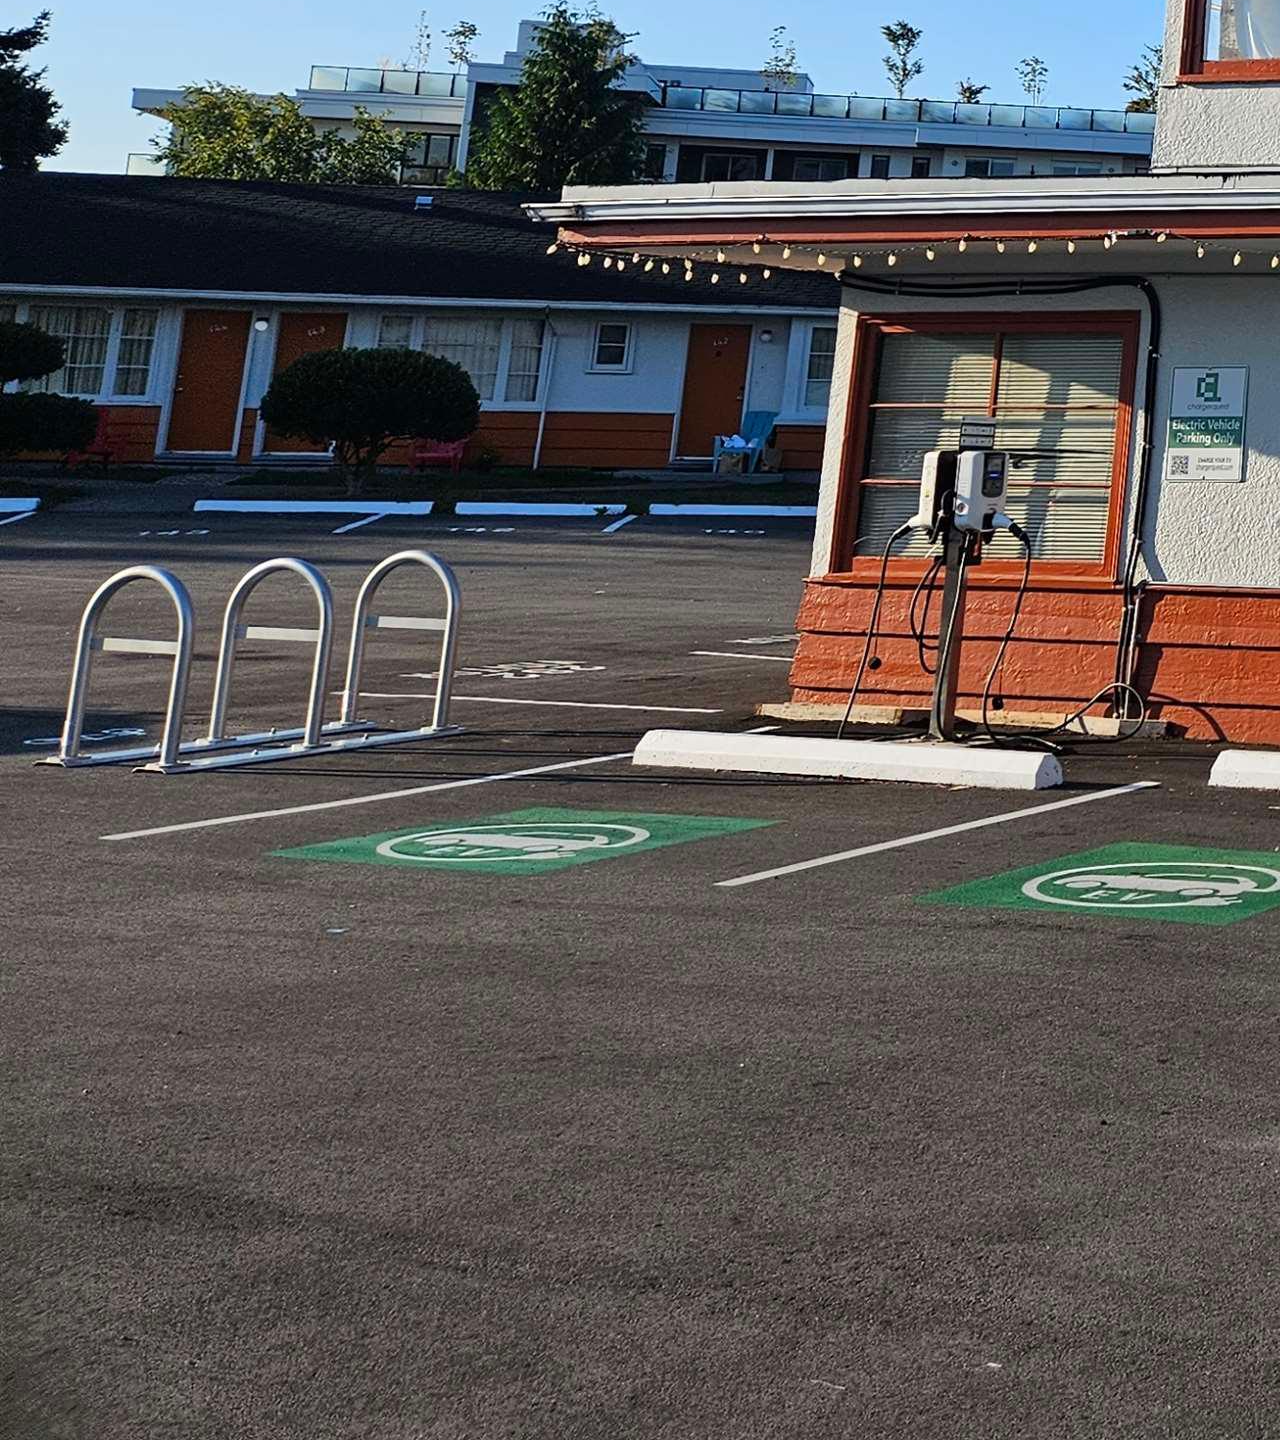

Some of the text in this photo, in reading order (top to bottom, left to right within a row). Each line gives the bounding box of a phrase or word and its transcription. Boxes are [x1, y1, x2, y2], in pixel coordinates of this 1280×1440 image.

[1172, 419, 1240, 431] Electric Vehicle
[1176, 432, 1235, 446] Parking Only
[1079, 889, 1157, 901] EV
